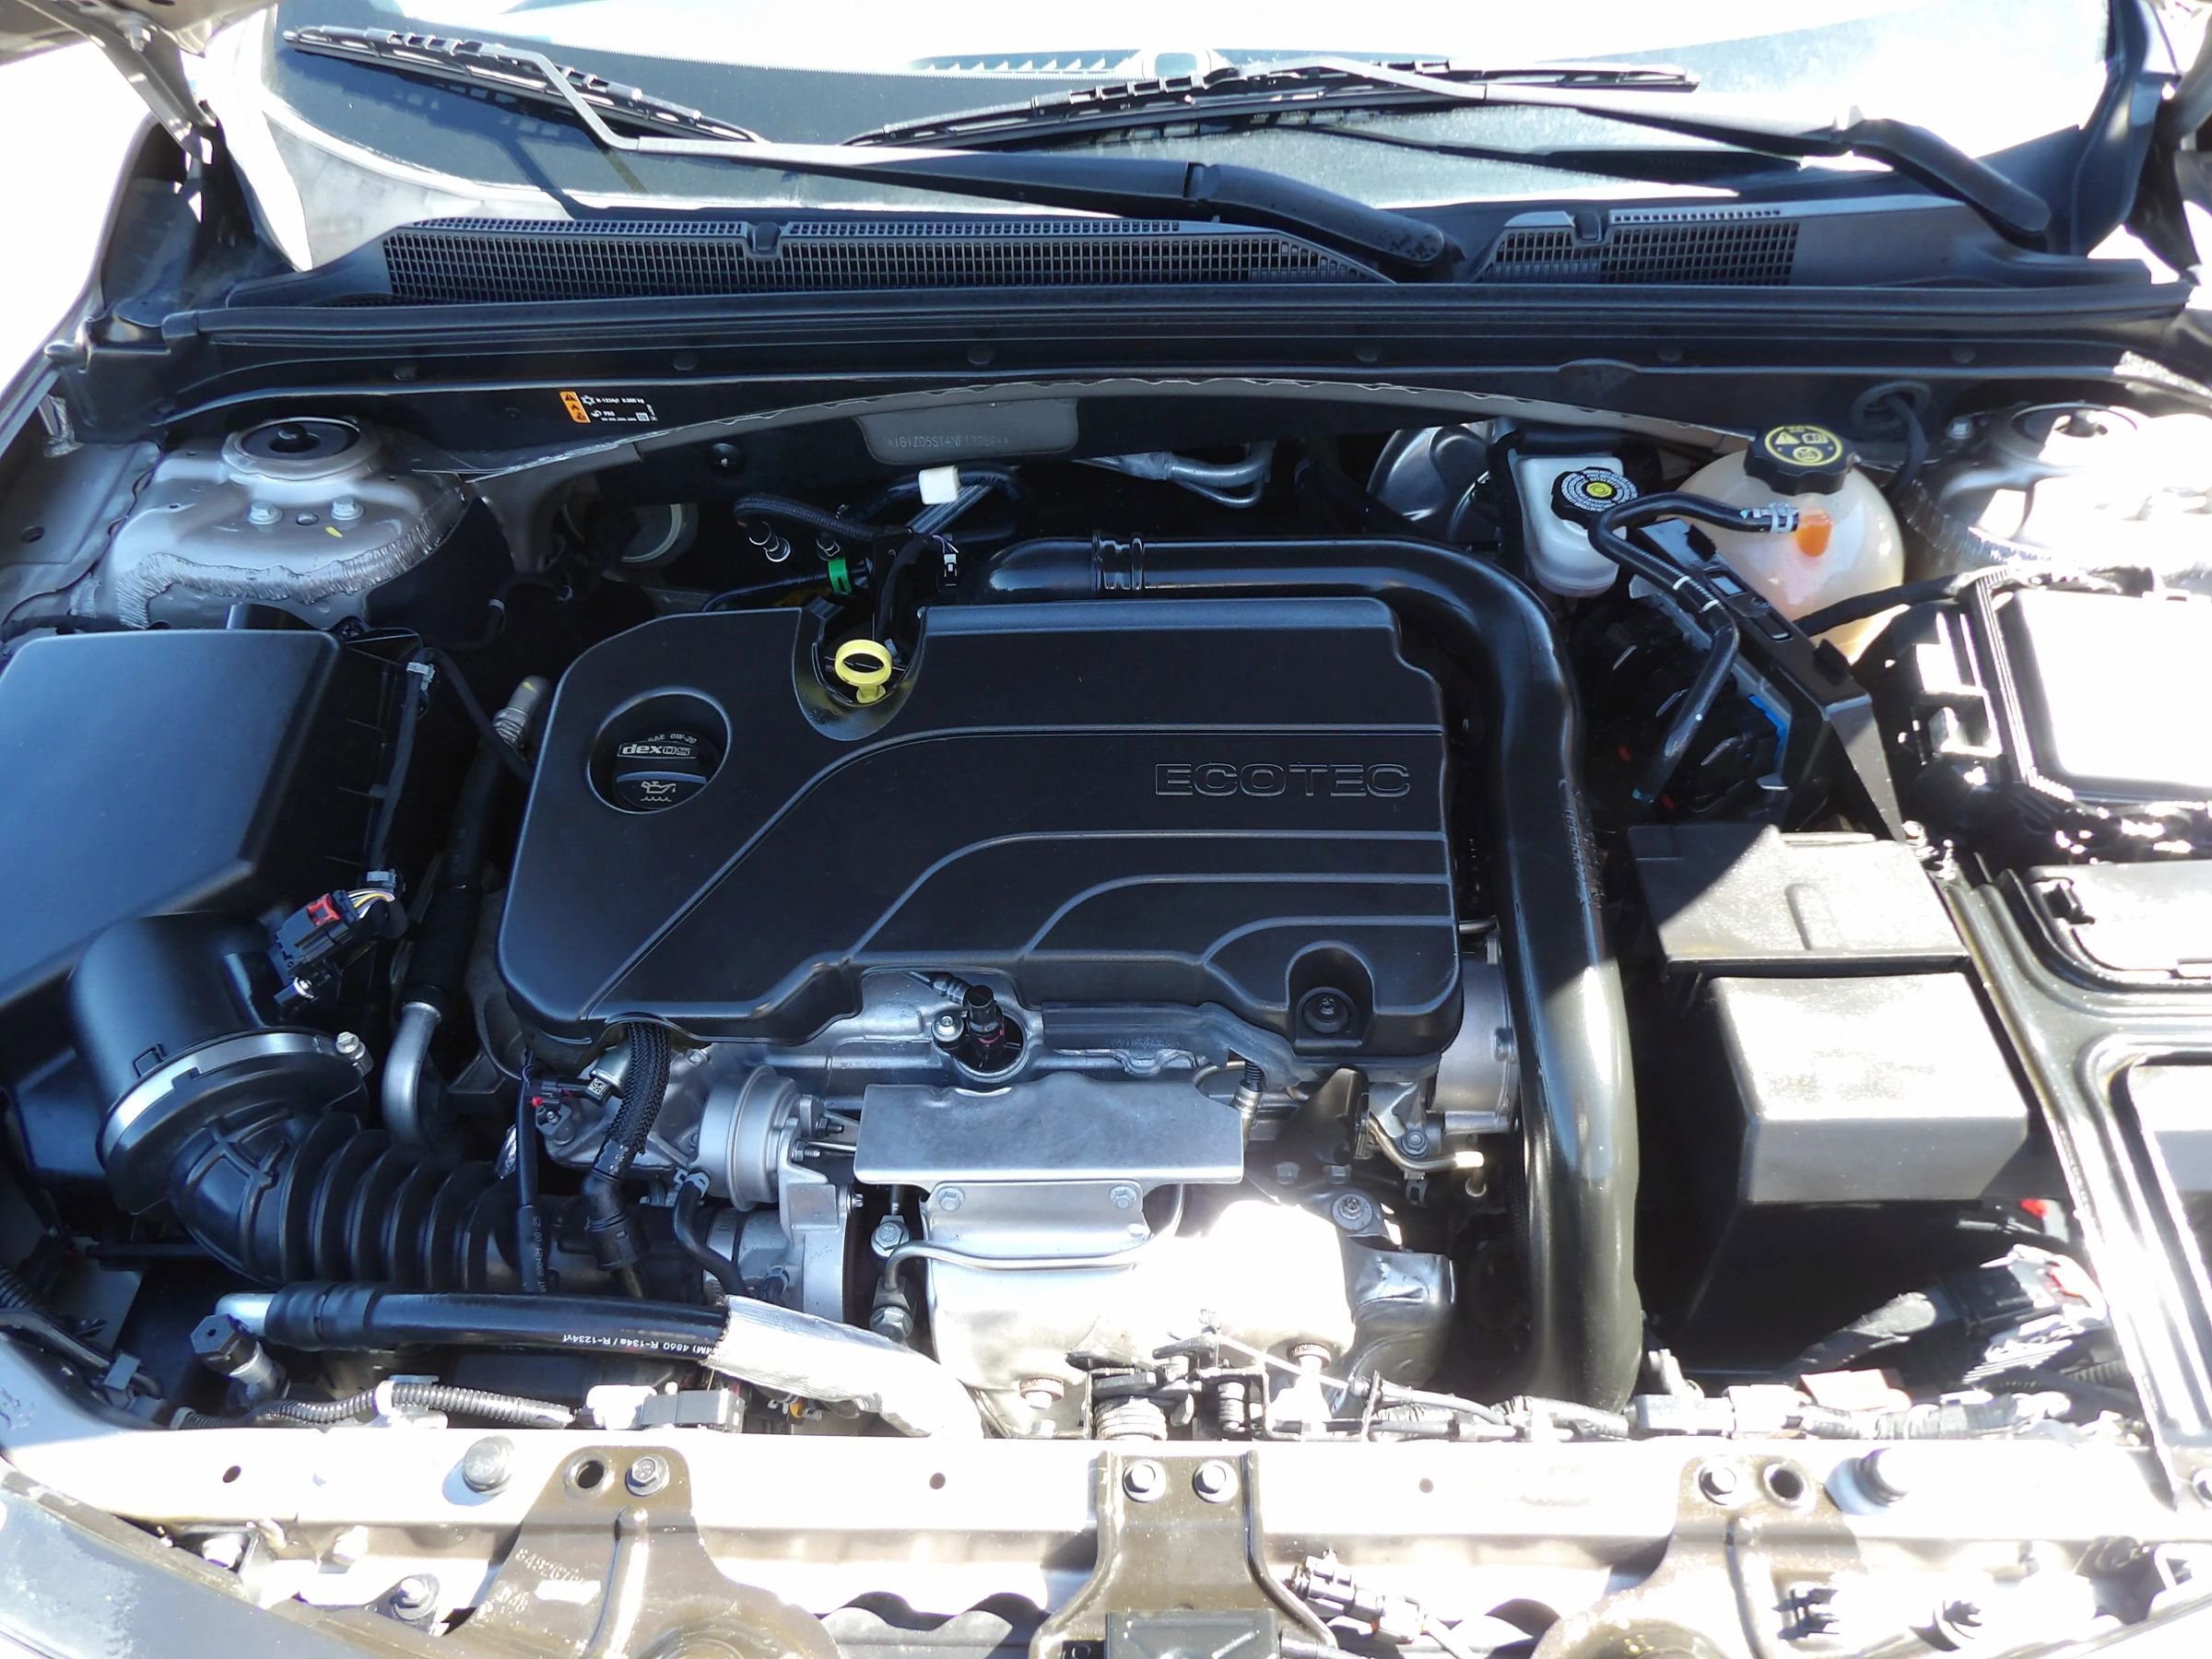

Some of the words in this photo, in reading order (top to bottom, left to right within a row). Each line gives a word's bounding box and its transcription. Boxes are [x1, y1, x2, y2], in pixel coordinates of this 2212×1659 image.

[622, 744, 691, 756] dexos
[1155, 762, 1411, 797] ECOTEC
[562, 1333, 611, 1346] R-1234yf
[620, 1337, 659, 1349] R-134a
[663, 1341, 689, 1352] 4860
